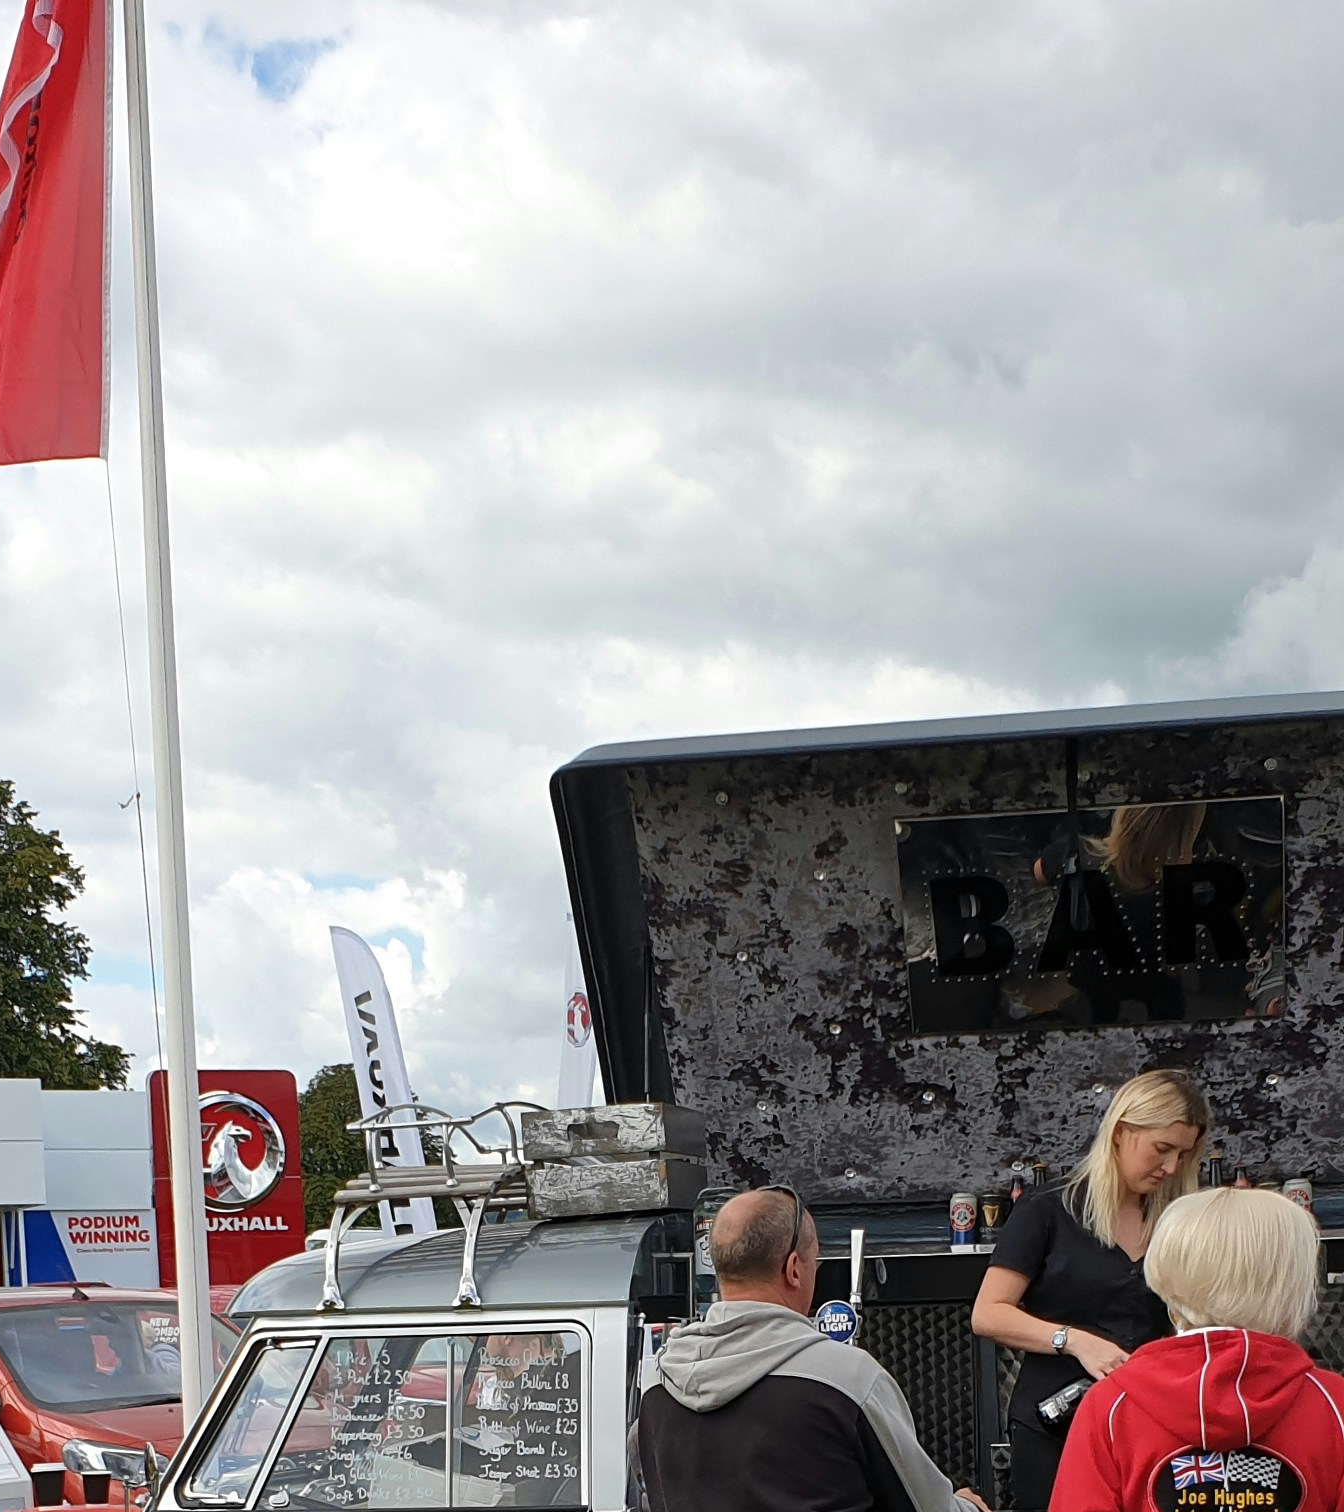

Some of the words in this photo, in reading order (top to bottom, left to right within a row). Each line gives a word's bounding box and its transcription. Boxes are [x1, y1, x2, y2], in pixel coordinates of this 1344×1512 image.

[930, 860, 1253, 976] BAR
[68, 1215, 140, 1229] PODIUM
[205, 1216, 289, 1232] UXHALL
[68, 1230, 150, 1244] WINNING
[824, 1313, 849, 1323] BUD
[155, 1326, 180, 1337] OMBO
[820, 1321, 854, 1332] LIGHT
[516, 1440, 545, 1455] Bomb
[1177, 1489, 1207, 1505] Joe
[1214, 1489, 1275, 1507] Hughes
